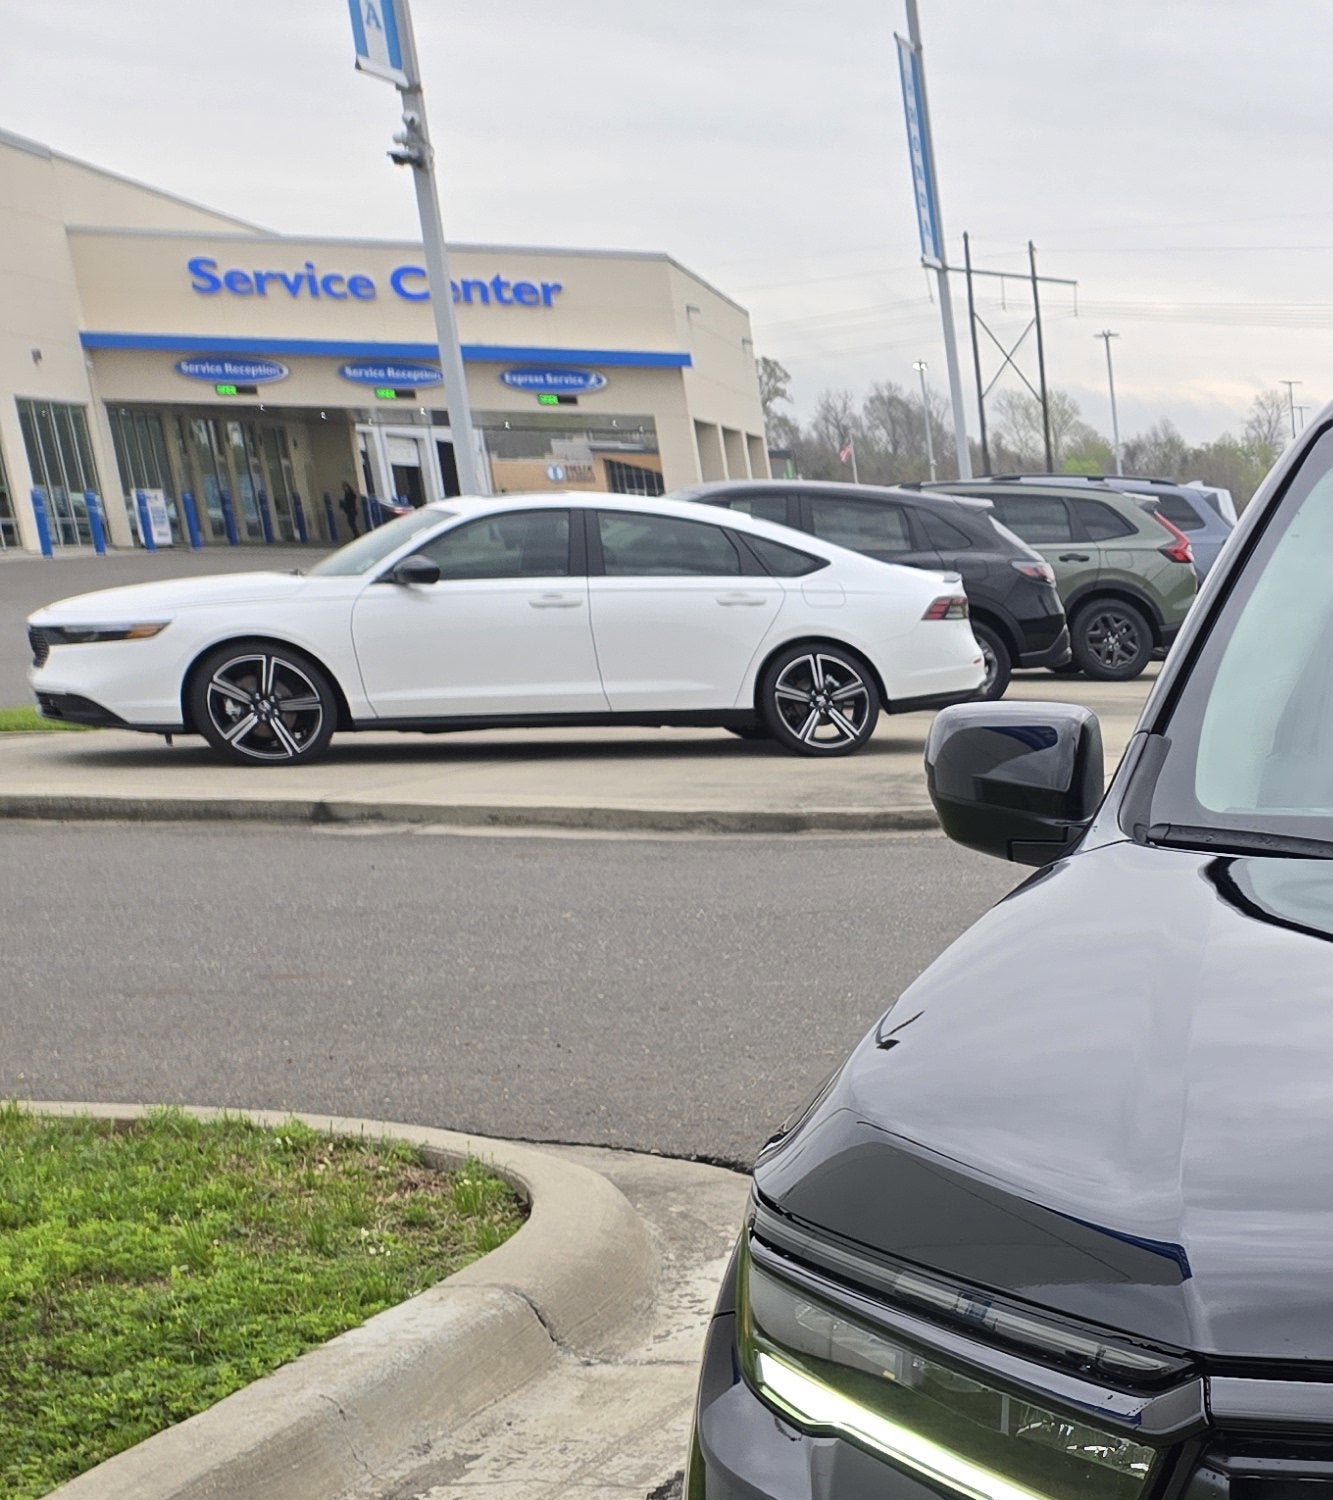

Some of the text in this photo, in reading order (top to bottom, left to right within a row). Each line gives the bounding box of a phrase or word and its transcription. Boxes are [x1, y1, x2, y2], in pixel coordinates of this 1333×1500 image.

[187, 256, 377, 300] Service
[179, 361, 280, 378] Service Reception
[344, 366, 385, 378] Service
[504, 372, 583, 385] Express Service
